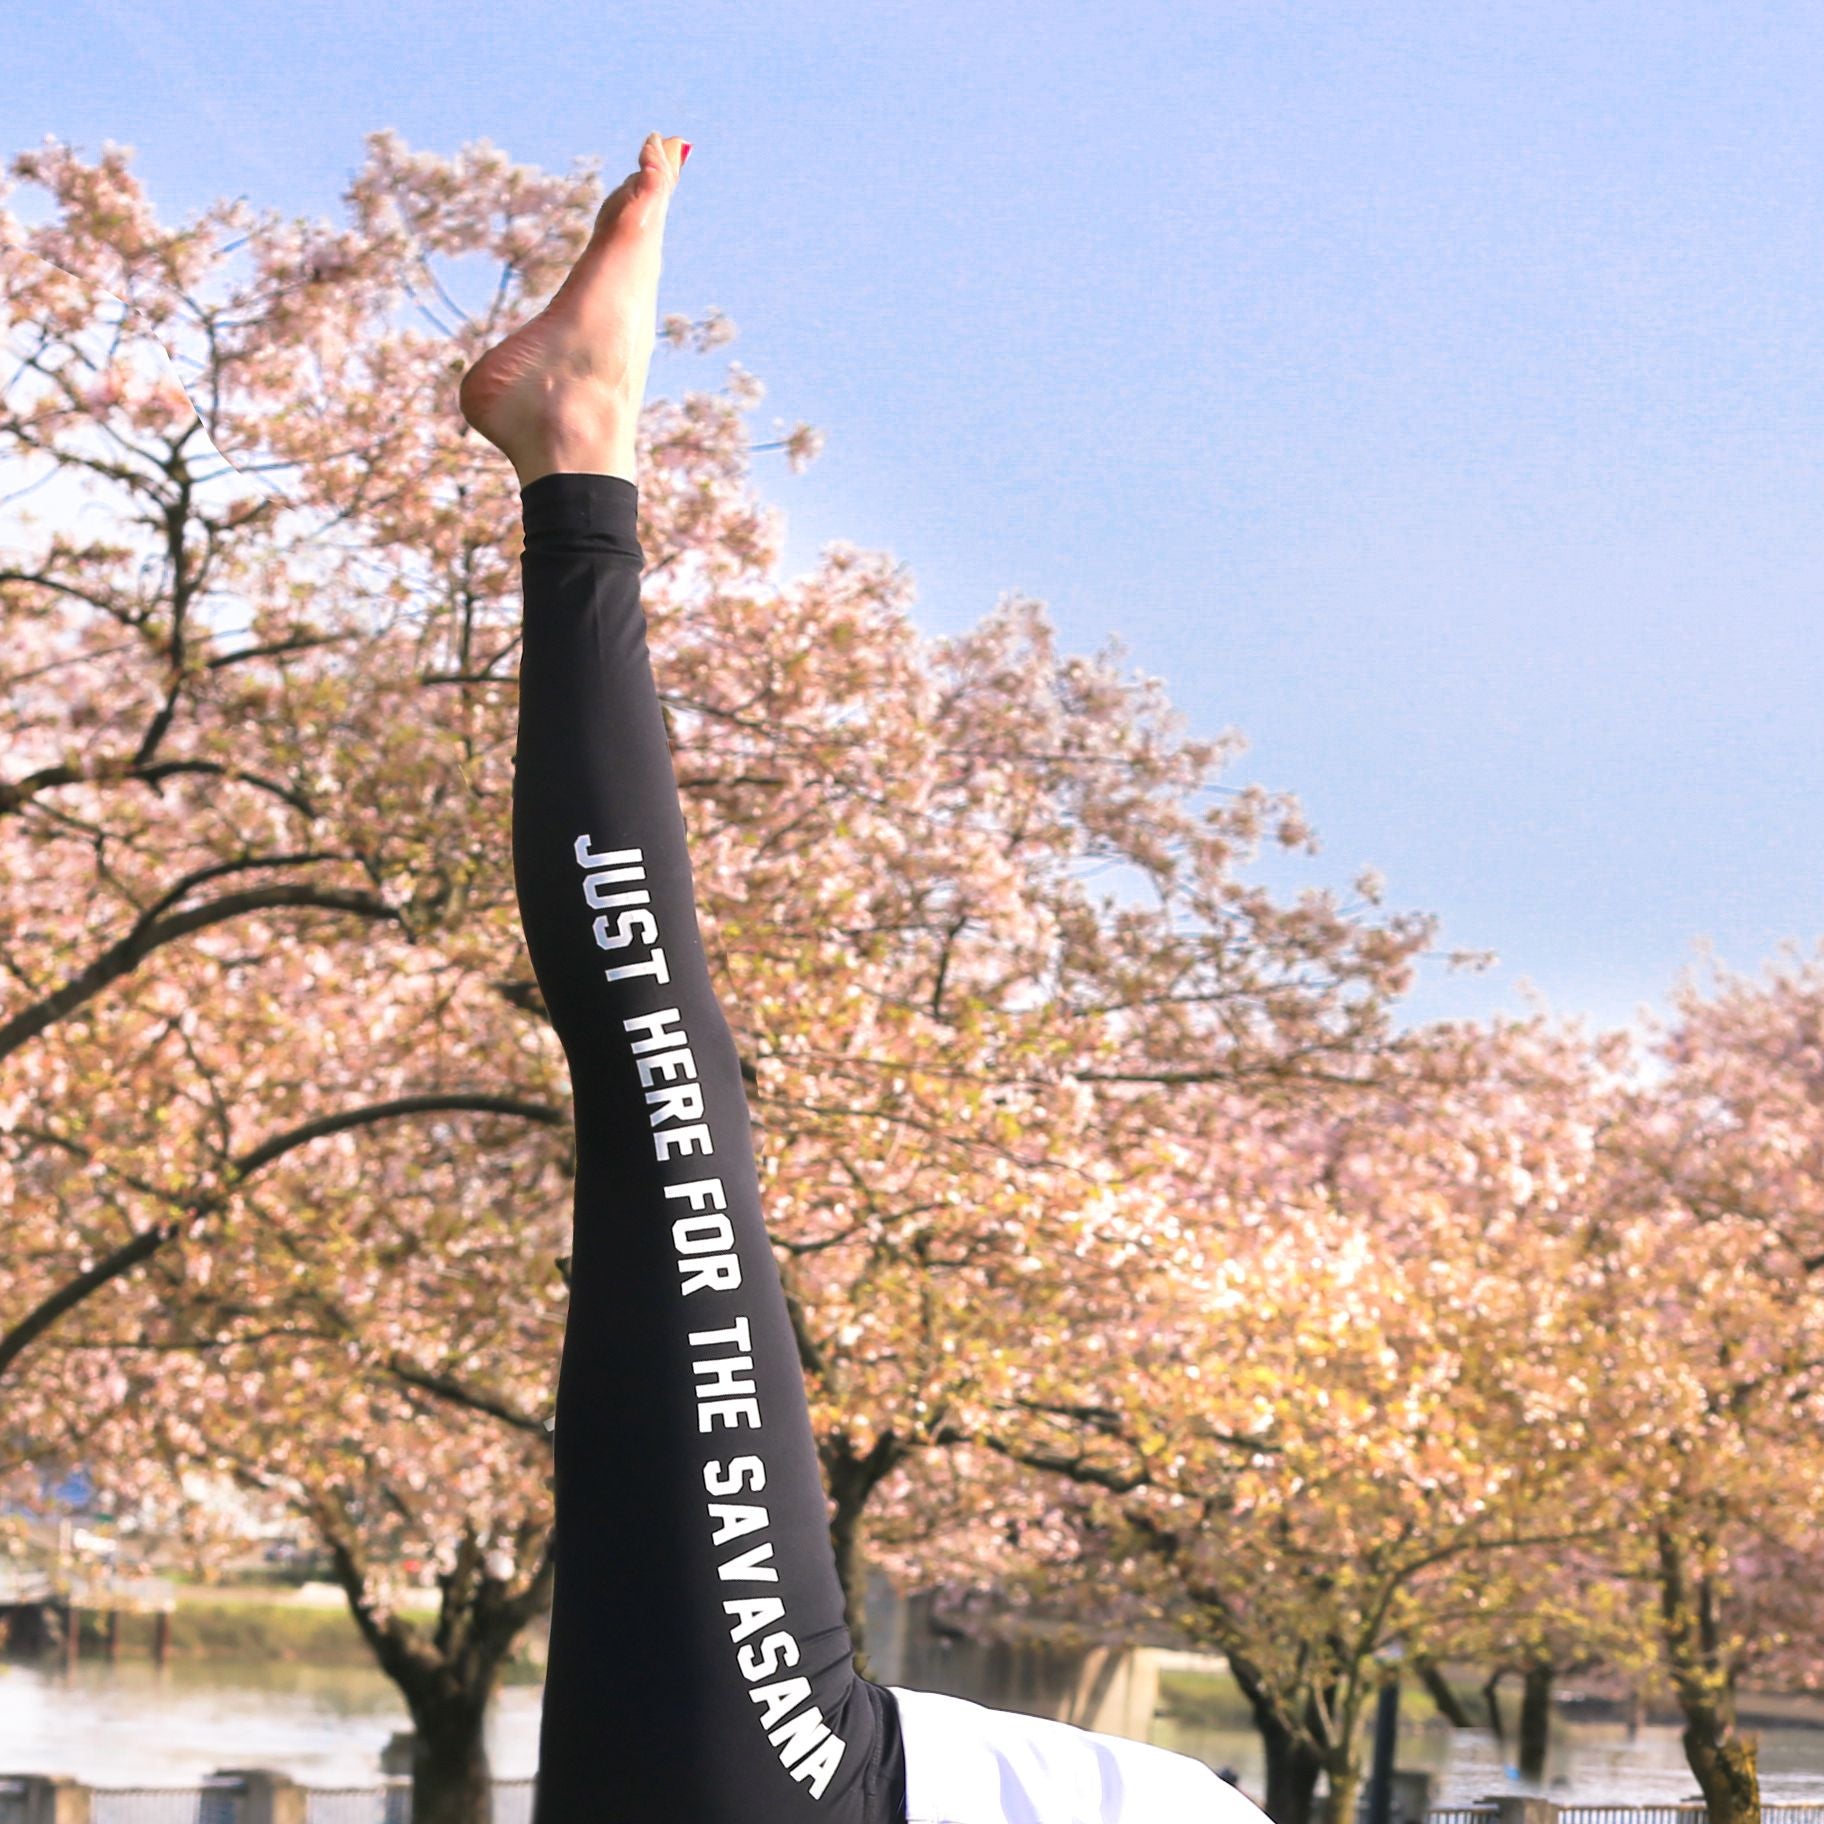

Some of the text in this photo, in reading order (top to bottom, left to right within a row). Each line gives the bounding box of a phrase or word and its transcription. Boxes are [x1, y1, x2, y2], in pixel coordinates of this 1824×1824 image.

[574, 834, 847, 1800] JUST HERE FOR THE SAVASANA
